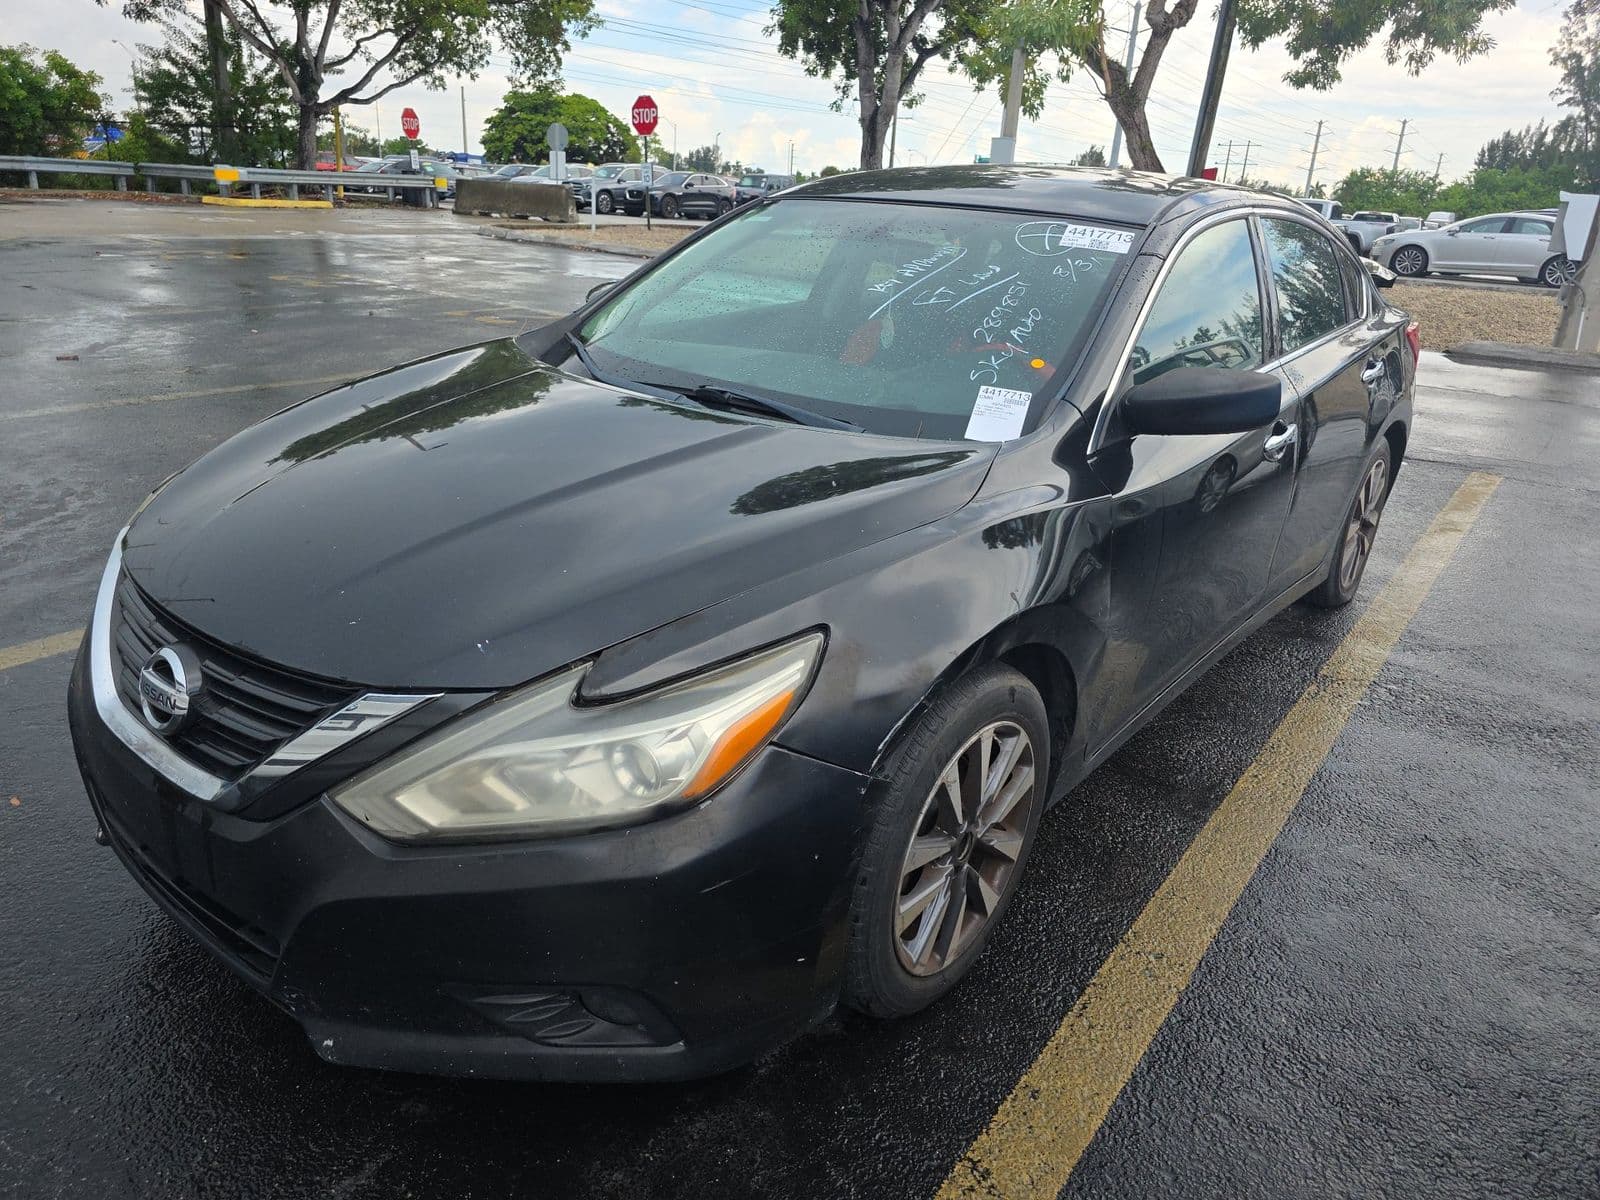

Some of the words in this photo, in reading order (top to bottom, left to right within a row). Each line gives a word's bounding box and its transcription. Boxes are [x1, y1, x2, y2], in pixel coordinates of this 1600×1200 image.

[633, 108, 657, 123] STOP
[402, 117, 420, 130] STOP
[1067, 227, 1134, 242] 4417713
[982, 387, 1031, 402] 4417713
